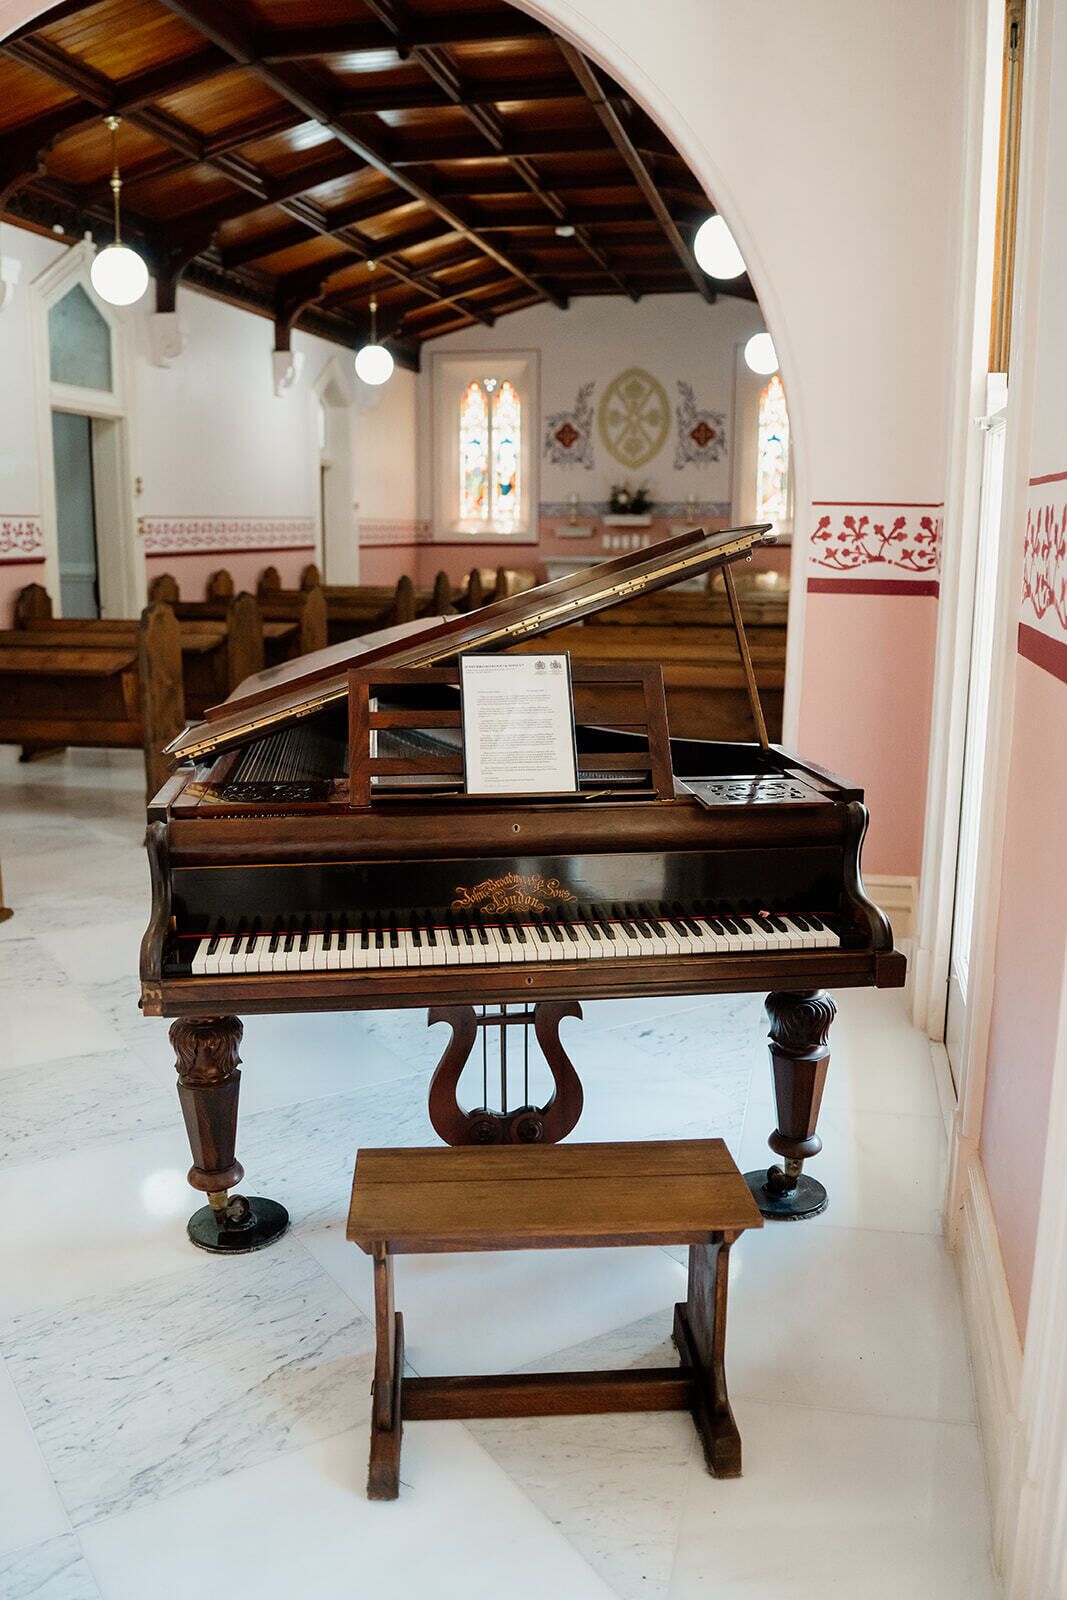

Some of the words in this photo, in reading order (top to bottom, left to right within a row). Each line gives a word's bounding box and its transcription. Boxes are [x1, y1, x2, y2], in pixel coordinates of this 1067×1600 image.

[478, 872, 541, 892] Broadwd
[546, 878, 577, 903] Sons
[481, 888, 548, 914] London
